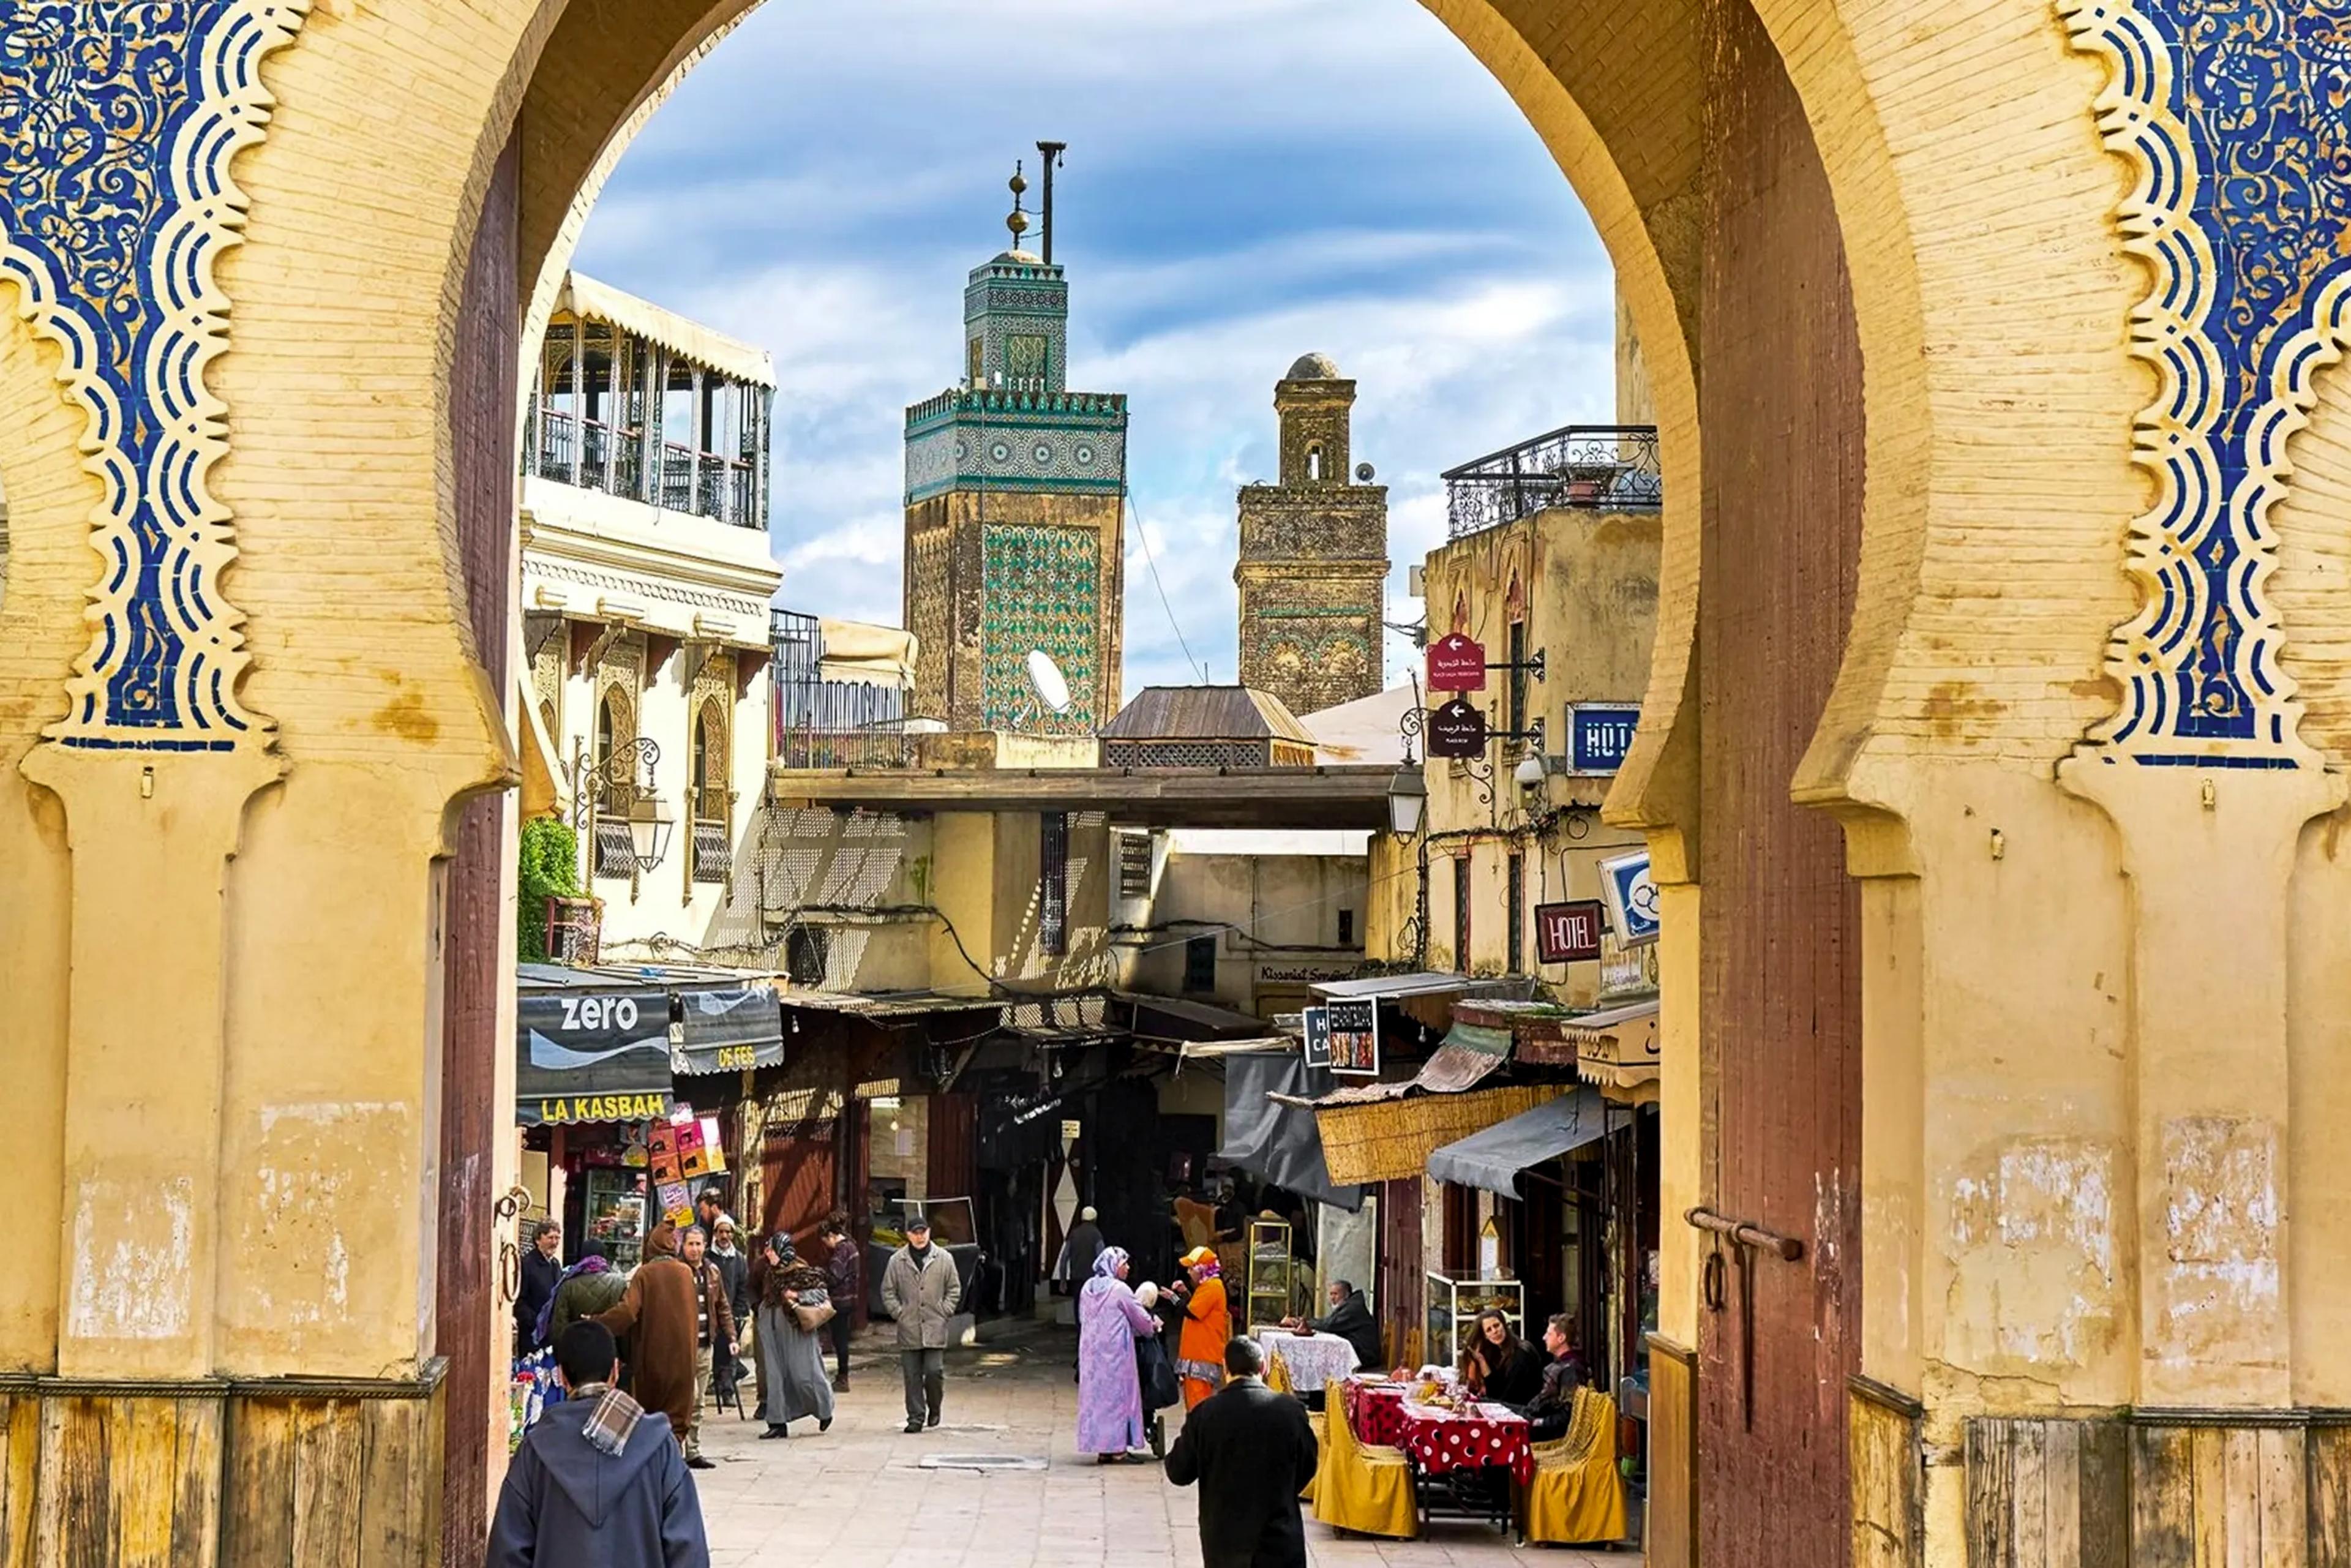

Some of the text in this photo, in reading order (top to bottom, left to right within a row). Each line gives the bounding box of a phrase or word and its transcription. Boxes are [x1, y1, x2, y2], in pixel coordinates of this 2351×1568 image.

[1587, 722, 1637, 757] HOT
[1548, 915, 1597, 952] HOTEL
[560, 997, 639, 1030] zero
[542, 1099, 569, 1121] LA
[574, 1094, 666, 1120] KASBAH
